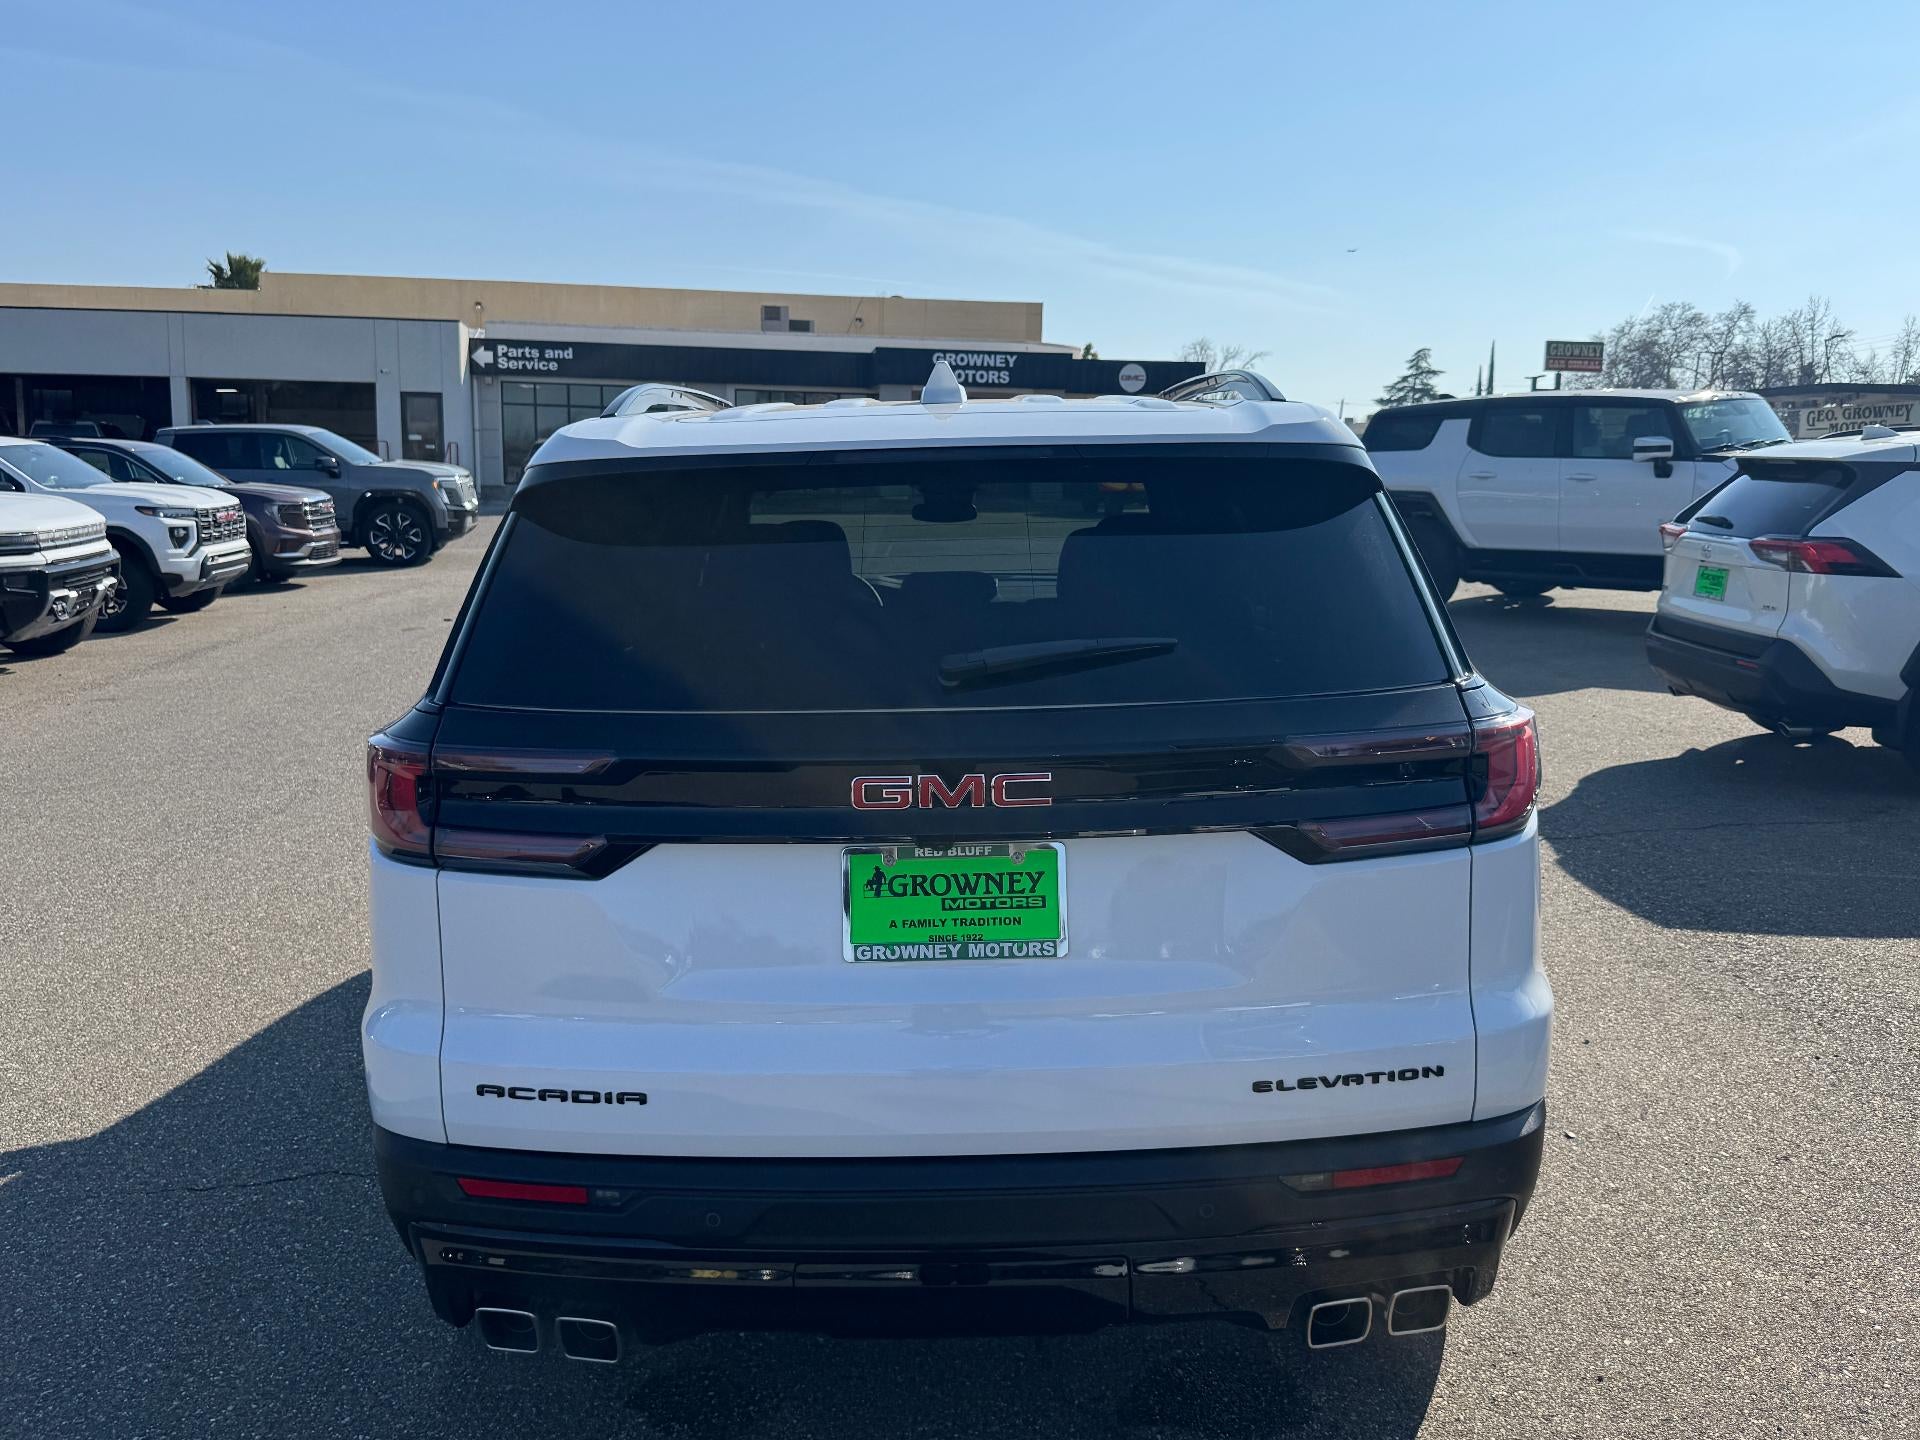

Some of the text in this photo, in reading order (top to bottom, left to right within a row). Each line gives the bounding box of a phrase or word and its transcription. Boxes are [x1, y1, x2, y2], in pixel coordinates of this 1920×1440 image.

[497, 344, 574, 360] Parts and
[932, 352, 1018, 368] GROWNEY
[497, 357, 558, 371] Service
[954, 369, 1010, 384] OTORS
[1120, 374, 1145, 382] GMC
[1806, 403, 1914, 427] GEO. GROWNEY
[851, 772, 1052, 810] GMC
[914, 845, 993, 857] RED BLUFF
[887, 870, 1046, 897] GROWNEY
[944, 897, 1043, 909] MOTORS
[888, 916, 1022, 929] A FAMILY TRADITION
[928, 933, 984, 943] SINCE 1922
[856, 941, 1056, 961] GROWNEY MOTORS
[1251, 1065, 1445, 1093] ELEVATION
[476, 1083, 648, 1106] ACADIA
